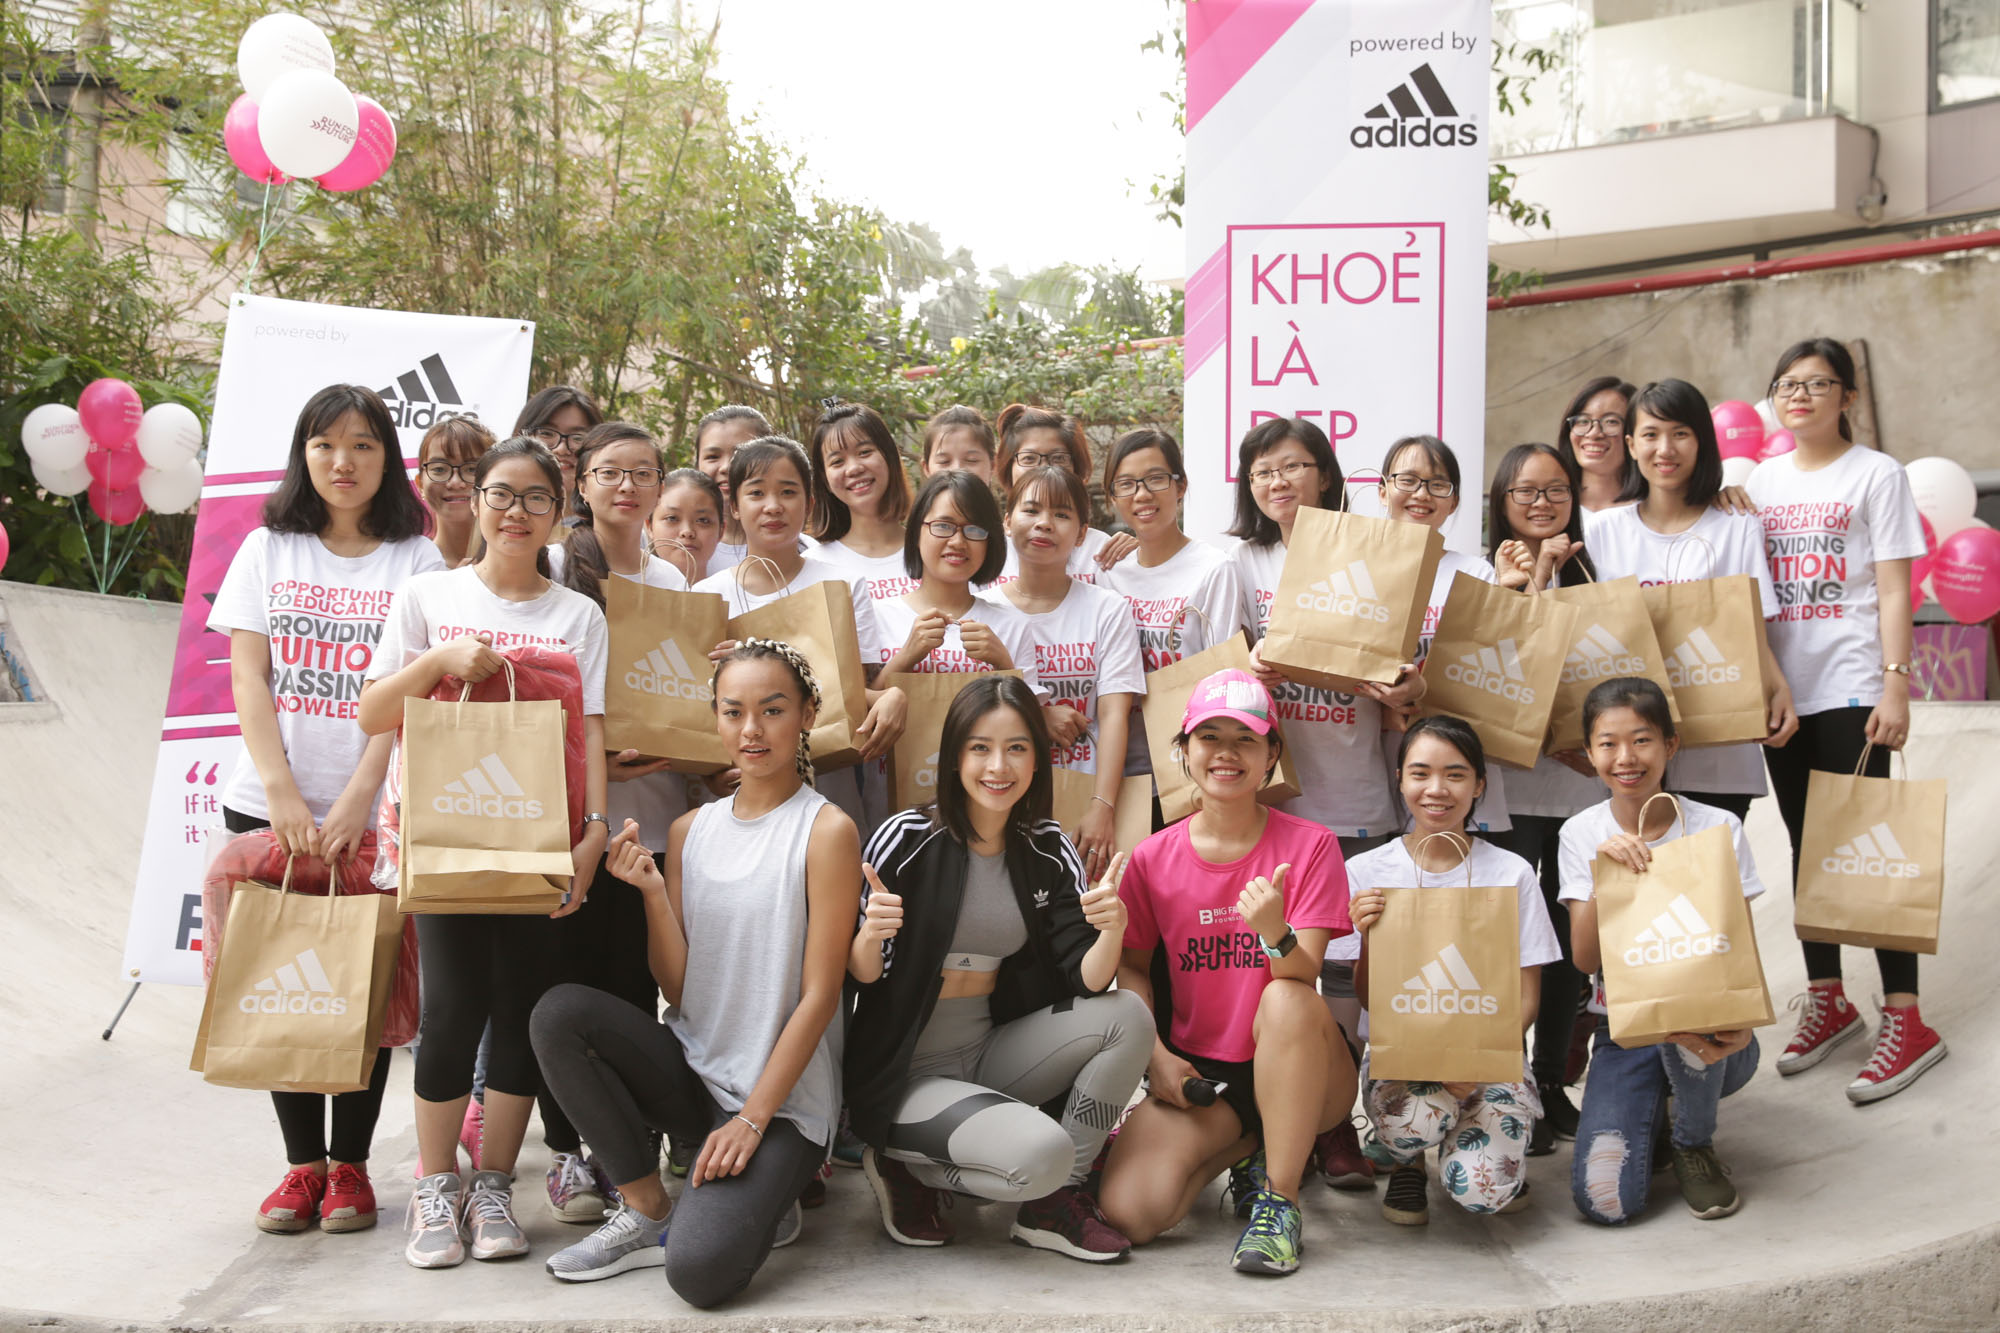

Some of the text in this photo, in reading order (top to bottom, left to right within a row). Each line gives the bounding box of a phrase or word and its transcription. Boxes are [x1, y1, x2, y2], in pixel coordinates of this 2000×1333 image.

[1350, 31, 1478, 58] powered by
[320, 115, 341, 130] RUN
[1350, 116, 1478, 148] adidas
[1251, 231, 1421, 305] KHOẺ
[254, 323, 350, 343] powered by
[1251, 320, 1320, 386] LÀ
[1767, 535, 1846, 556] OVIDING
[1768, 553, 1847, 582] ITION
[271, 579, 394, 605] OPPORTUNIT
[1773, 579, 1844, 605] SSING
[268, 594, 391, 618] TO EDUCATIO
[1296, 592, 1391, 623] adidas
[269, 615, 385, 643] PROVIDIN
[272, 636, 373, 672] TUITIO
[624, 671, 713, 702] adidas
[1444, 663, 1537, 705] adidas
[1669, 662, 1742, 688] didas
[1277, 702, 1356, 725] WLEDGE
[185, 794, 219, 815] If it
[432, 793, 544, 818] adidas
[185, 825, 200, 844] it
[1821, 855, 1921, 878] adidas
[1213, 907, 1228, 917] BIG
[1187, 933, 1231, 956] RUN
[1624, 932, 1732, 967] adidas
[1194, 950, 1266, 973] FUTURE
[239, 989, 348, 1015] adidas
[1391, 989, 1498, 1016] adidas
